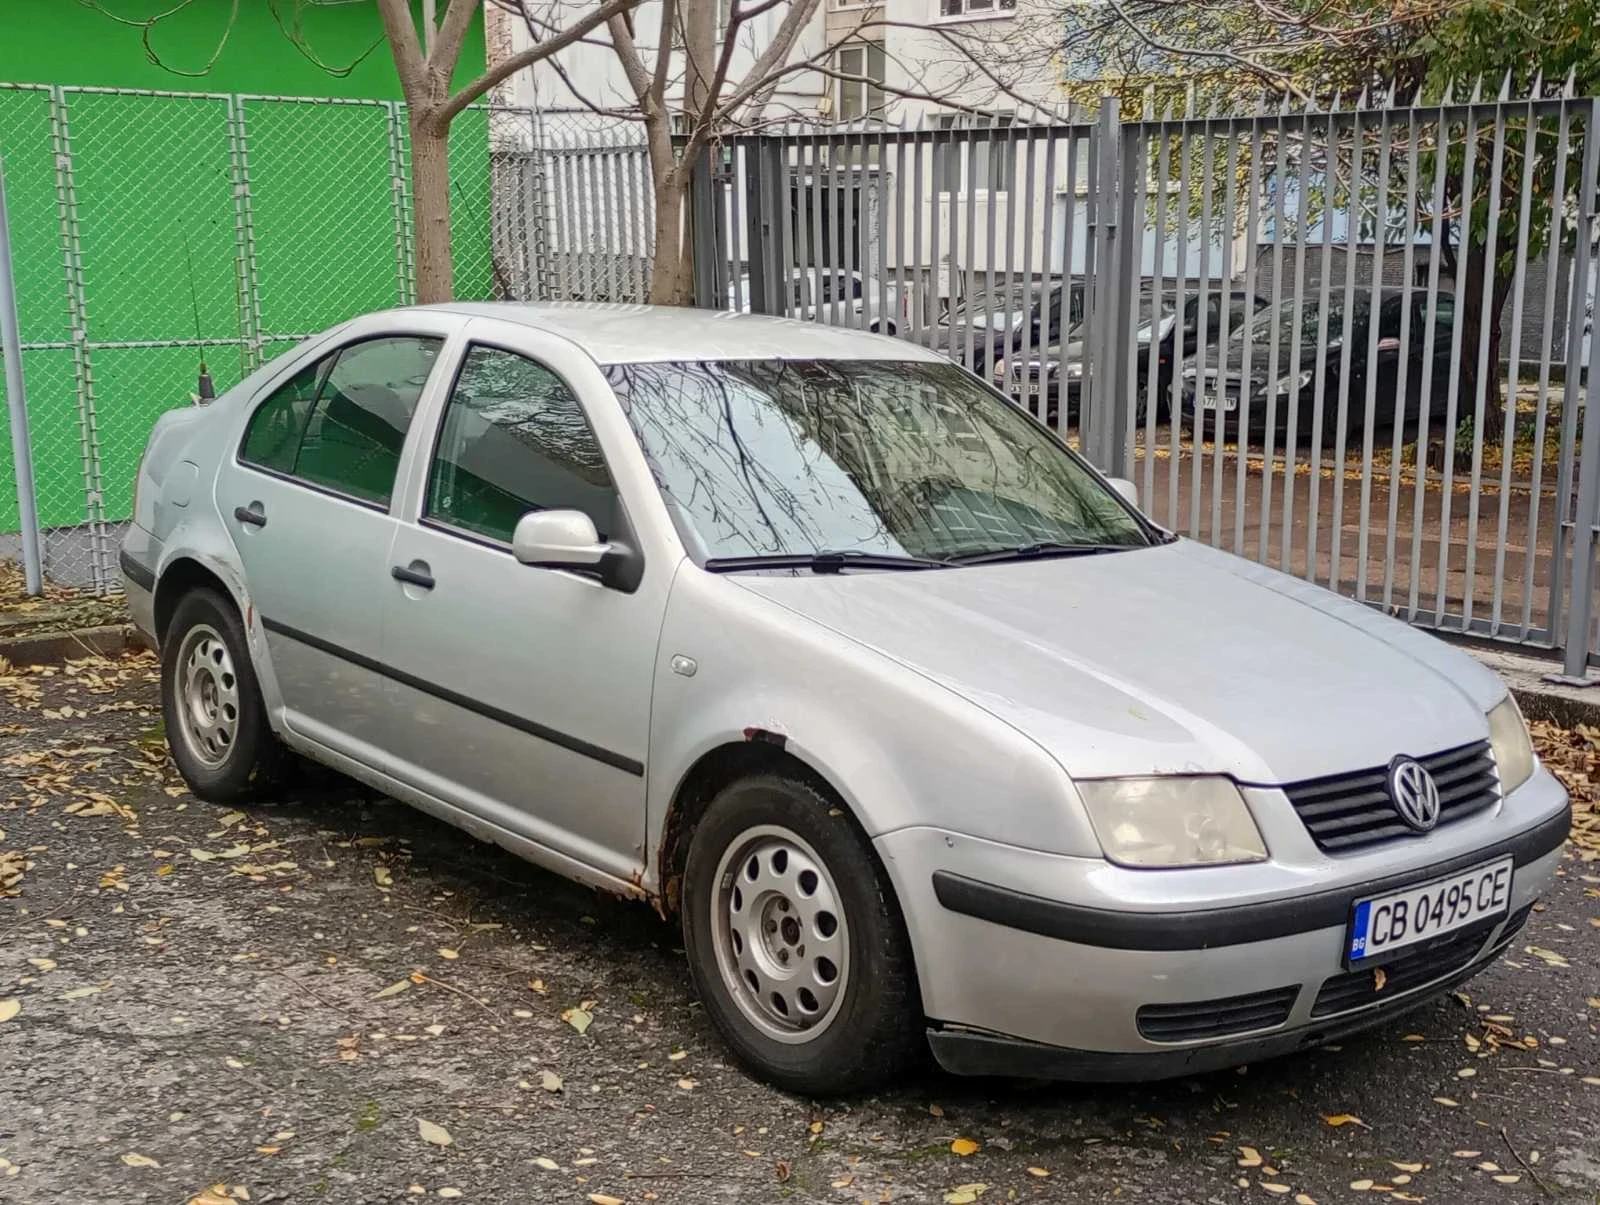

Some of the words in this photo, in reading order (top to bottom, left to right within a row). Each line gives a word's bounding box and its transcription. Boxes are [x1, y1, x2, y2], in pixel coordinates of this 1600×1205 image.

[1392, 761, 1440, 827] VW
[1371, 900, 1409, 946] CB
[1414, 879, 1474, 934] 0495
[1476, 866, 1509, 912] CE
[1352, 936, 1366, 951] BG
